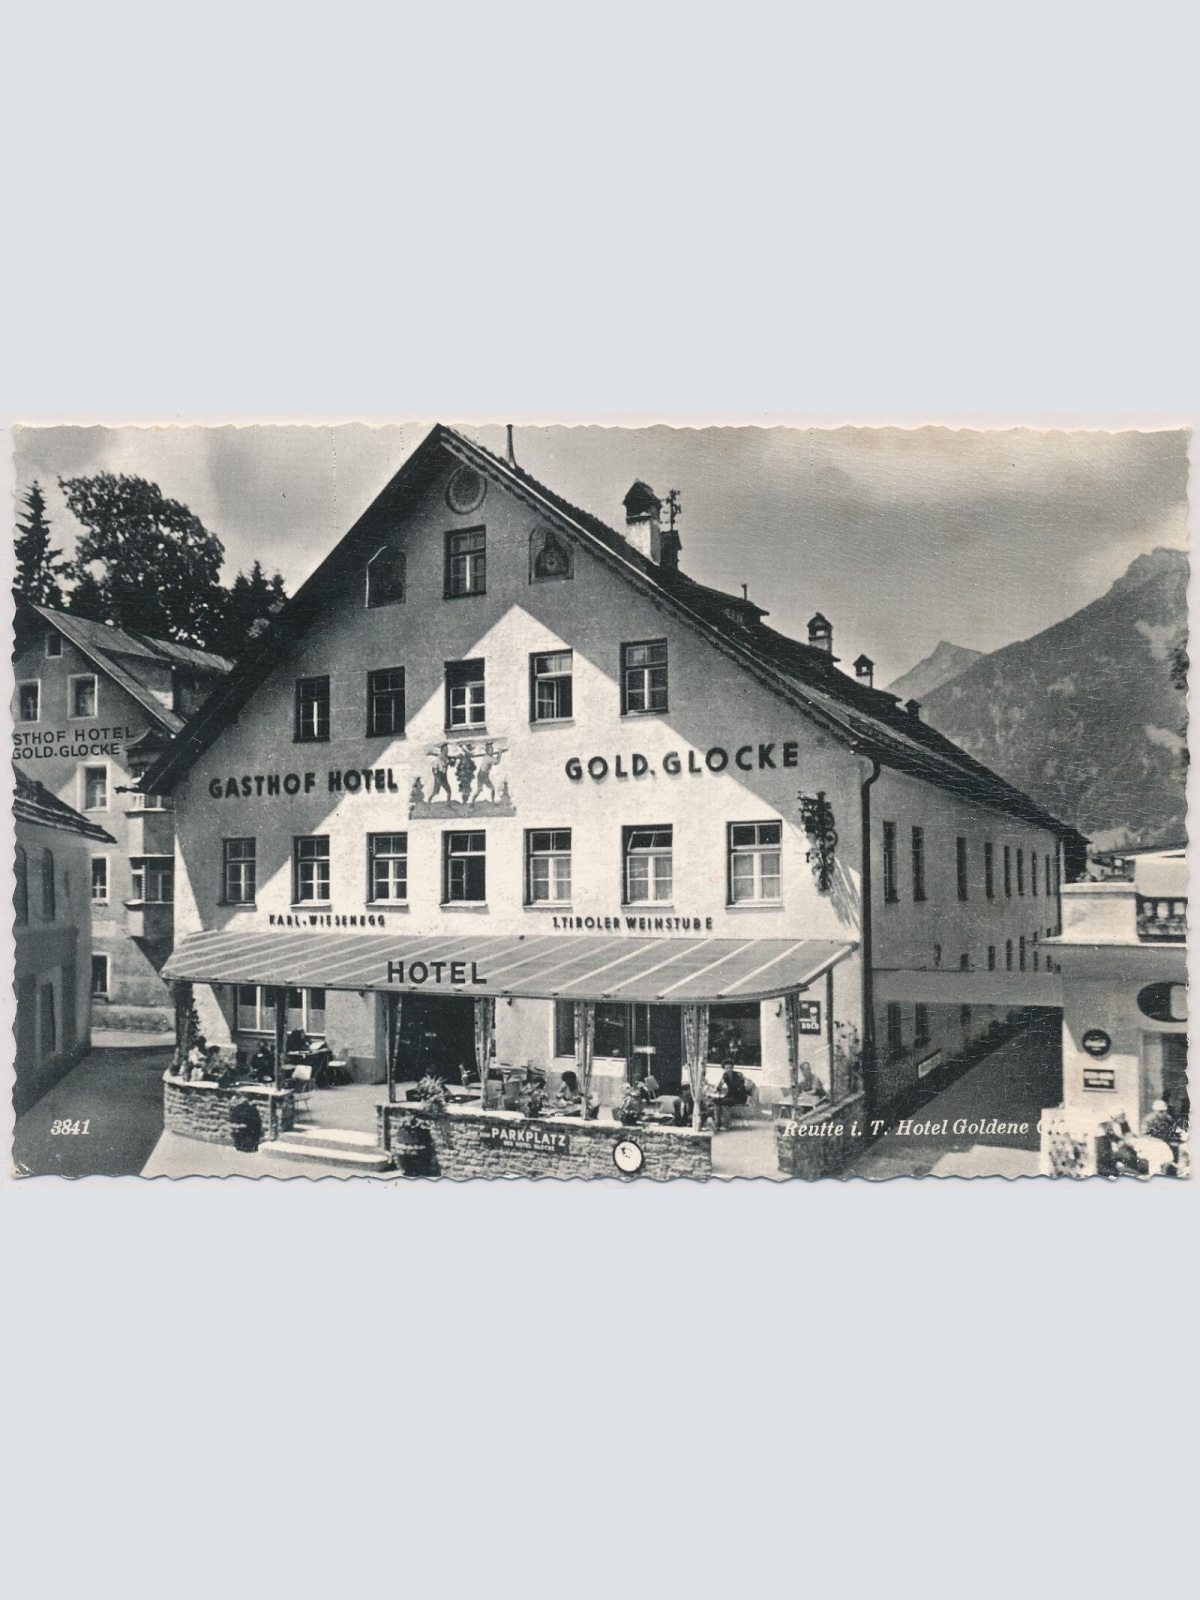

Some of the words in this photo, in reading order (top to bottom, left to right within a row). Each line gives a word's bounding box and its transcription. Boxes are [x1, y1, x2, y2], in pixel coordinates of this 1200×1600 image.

[75, 726, 136, 742] HOTEL
[209, 772, 316, 799] GASTHOF
[328, 768, 398, 793] HOTEL
[626, 917, 713, 930] WEINSTUBE
[387, 961, 487, 984] HOTEL
[491, 1127, 566, 1147] PARKPLATZ
